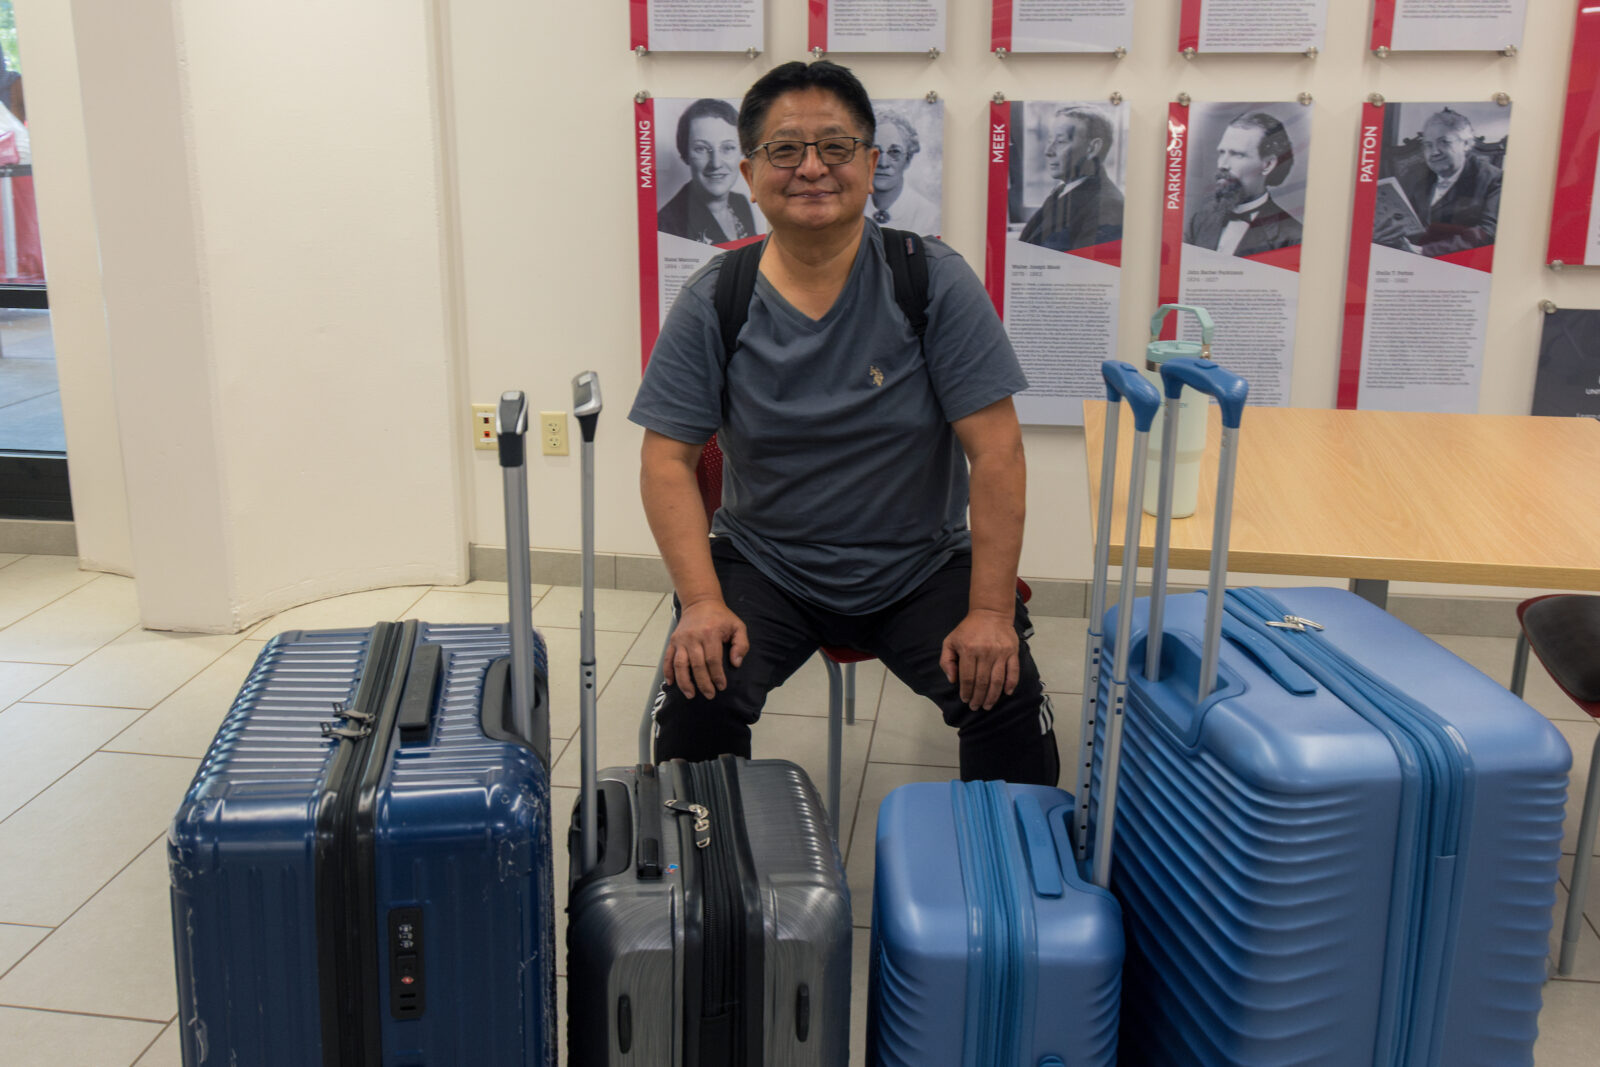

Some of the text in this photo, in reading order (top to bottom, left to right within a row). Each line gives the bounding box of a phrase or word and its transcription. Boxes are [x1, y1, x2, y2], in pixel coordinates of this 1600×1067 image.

[638, 120, 653, 188] MANNING
[992, 124, 1006, 163] MEEK
[1359, 126, 1378, 182] PATTON
